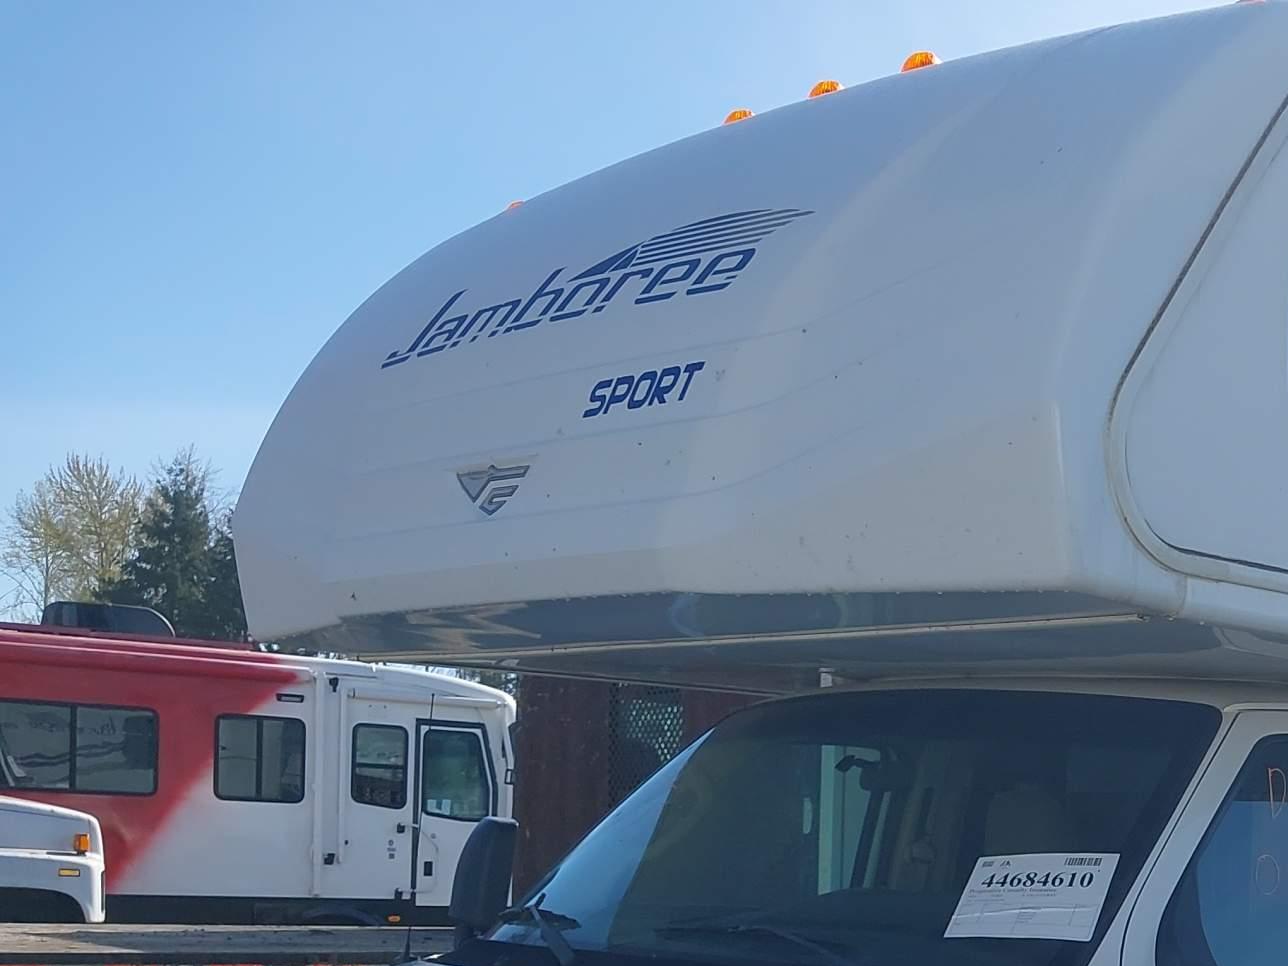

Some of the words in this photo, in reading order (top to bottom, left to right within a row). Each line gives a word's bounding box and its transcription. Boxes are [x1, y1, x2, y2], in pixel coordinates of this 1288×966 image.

[381, 247, 756, 370] Jamboree
[582, 360, 706, 419] SPORT
[981, 871, 1094, 889] 44684610
